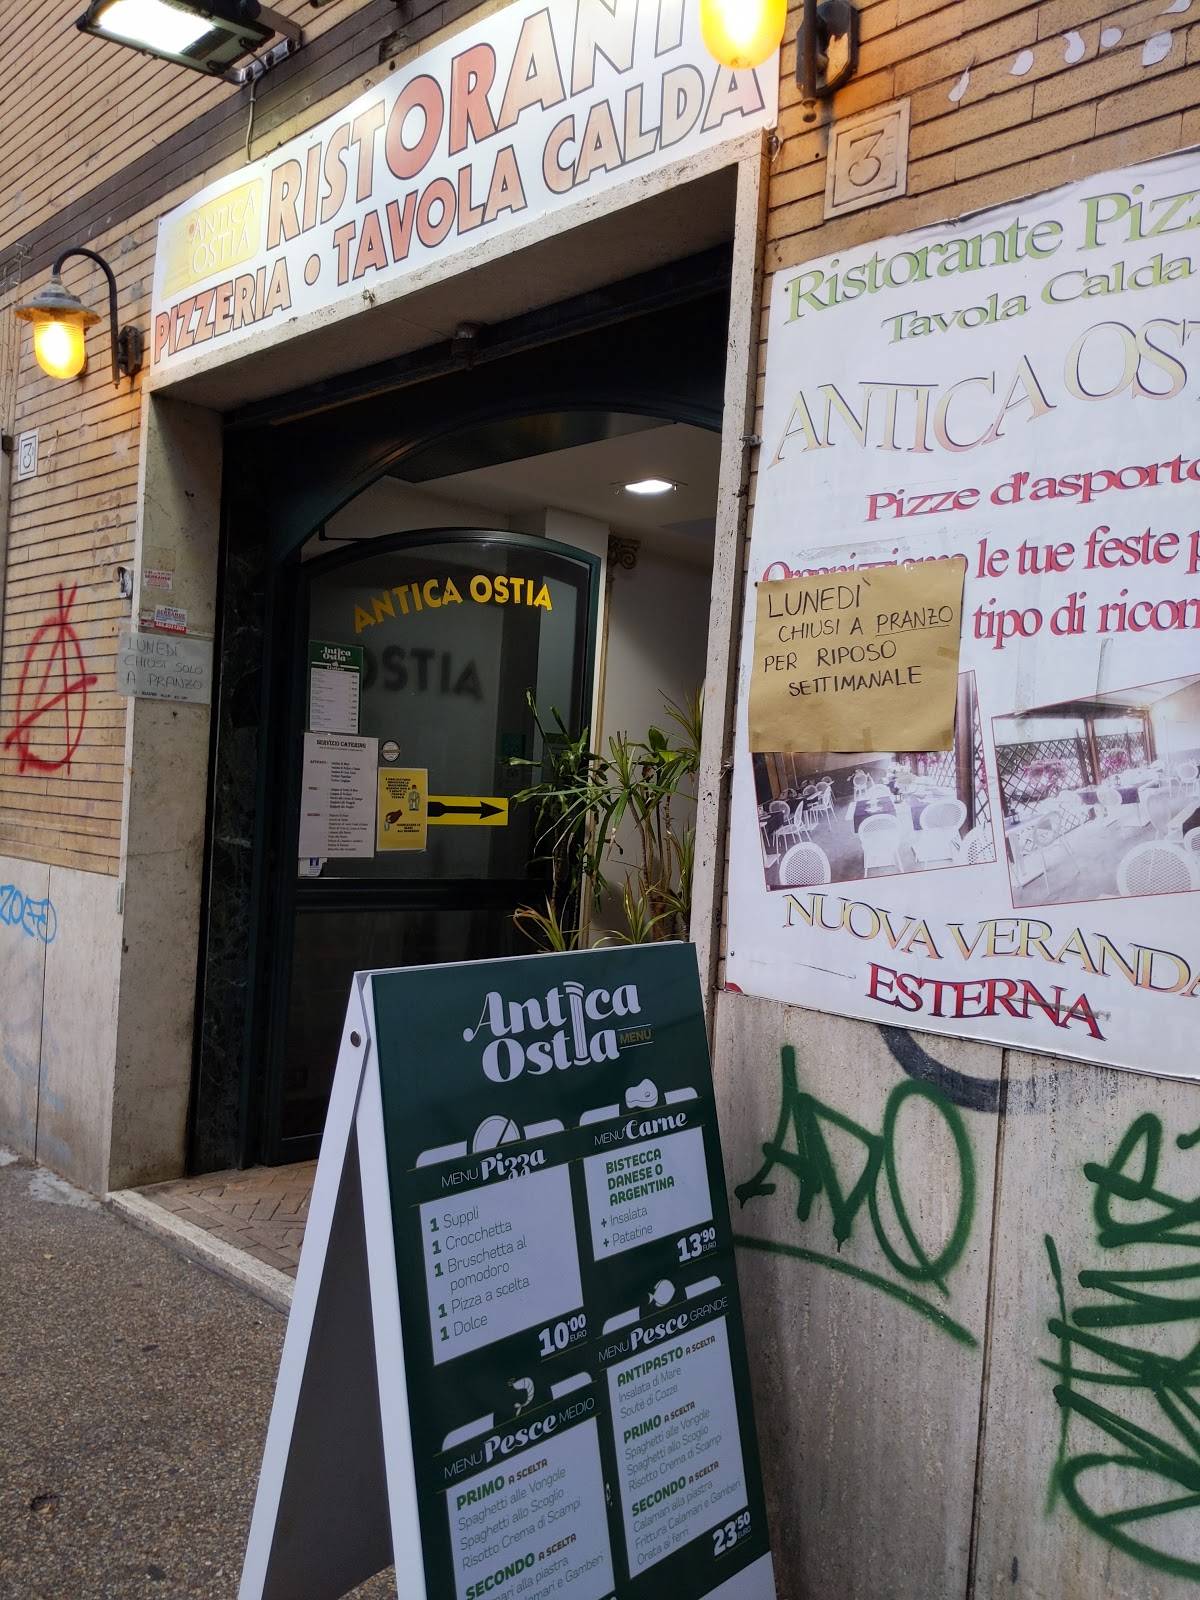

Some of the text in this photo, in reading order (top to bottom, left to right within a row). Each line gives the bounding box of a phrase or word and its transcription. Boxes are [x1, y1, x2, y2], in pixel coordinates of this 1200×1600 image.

[848, 130, 882, 187] 3
[154, 63, 765, 364] PIZZERIA TAVOLA CALDA
[192, 188, 257, 240] ANTICA
[192, 228, 251, 273] OSTIA
[783, 214, 1064, 325] Ristorante
[881, 252, 1197, 344] Tavola Calda
[767, 354, 1058, 470] ANTICA
[22, 442, 34, 468] 3
[864, 489, 981, 522] Pizze
[975, 538, 1009, 579] le
[1017, 540, 1076, 573] tue
[1083, 525, 1180, 570] feste
[353, 574, 553, 633] ANTICA OSTIA
[778, 605, 954, 643] CHIUSI A PRANZO
[972, 598, 1043, 650] tipo
[1050, 591, 1089, 635] di
[176, 662, 203, 675] SOLO
[320, 646, 351, 657] Antica
[322, 653, 346, 662] Ostia
[763, 639, 897, 672] PER RIPOSO
[127, 670, 202, 690] A PRANZO
[788, 665, 923, 697] SETTIMANALE
[782, 892, 944, 960] NUOVA
[463, 979, 641, 1041] Antica
[866, 962, 1107, 1042] ESTERNA
[482, 1028, 653, 1083] Ostia MENU
[594, 1112, 688, 1146] MENU Carne
[440, 1149, 548, 1189] MENU Pizza
[605, 1148, 662, 1174] BISTECCA
[607, 1164, 664, 1190] DANESE O
[609, 1176, 675, 1206] ARGENTINA
[430, 1217, 440, 1233] 1
[432, 1220, 513, 1255] 1 Crocchetta
[610, 1206, 648, 1226] Insalata
[612, 1224, 653, 1246] Patatine
[434, 1235, 528, 1278] 1 Bruschetta al
[702, 1241, 716, 1252] EURO
[438, 1276, 530, 1319] 1 Pizza a scelta
[450, 1261, 510, 1294] pomodoro
[440, 1314, 488, 1342] 1 Dolce
[569, 1329, 587, 1342] EURO
[598, 1297, 728, 1361] MENU Pesce GRANDE
[617, 1335, 716, 1387] ANTIPASTO A SCELTA
[618, 1367, 681, 1402] Insalata di Mare
[443, 1398, 595, 1479] MENU Pesce MEDIO
[624, 1401, 696, 1444] PRIMO A SCELTA
[624, 1408, 711, 1460] Spaghetti alle Vongole
[626, 1425, 709, 1477] Spaghetti allo Scoglio
[628, 1434, 722, 1492] Risotto Crema di Scampi
[456, 1458, 548, 1511] PRIMO A SCELTA
[458, 1467, 567, 1532] Spaghetti alle Vongole
[631, 1460, 720, 1517] SECONDO A SCELTA
[671, 1496, 685, 1511] alla
[687, 1480, 714, 1504] piastra
[459, 1487, 565, 1551] Spaghetti allo Scoglio
[462, 1496, 582, 1571] Risotto Crema di Scampi
[634, 1526, 668, 1550] Frittura
[465, 1552, 536, 1600] SECONDO
[538, 1551, 546, 1562] A
[546, 1533, 577, 1557] SCELTA
[516, 1575, 534, 1595] alla
[535, 1556, 570, 1585] piastra
[637, 1544, 663, 1566] Orata
[557, 1578, 564, 1587] e
